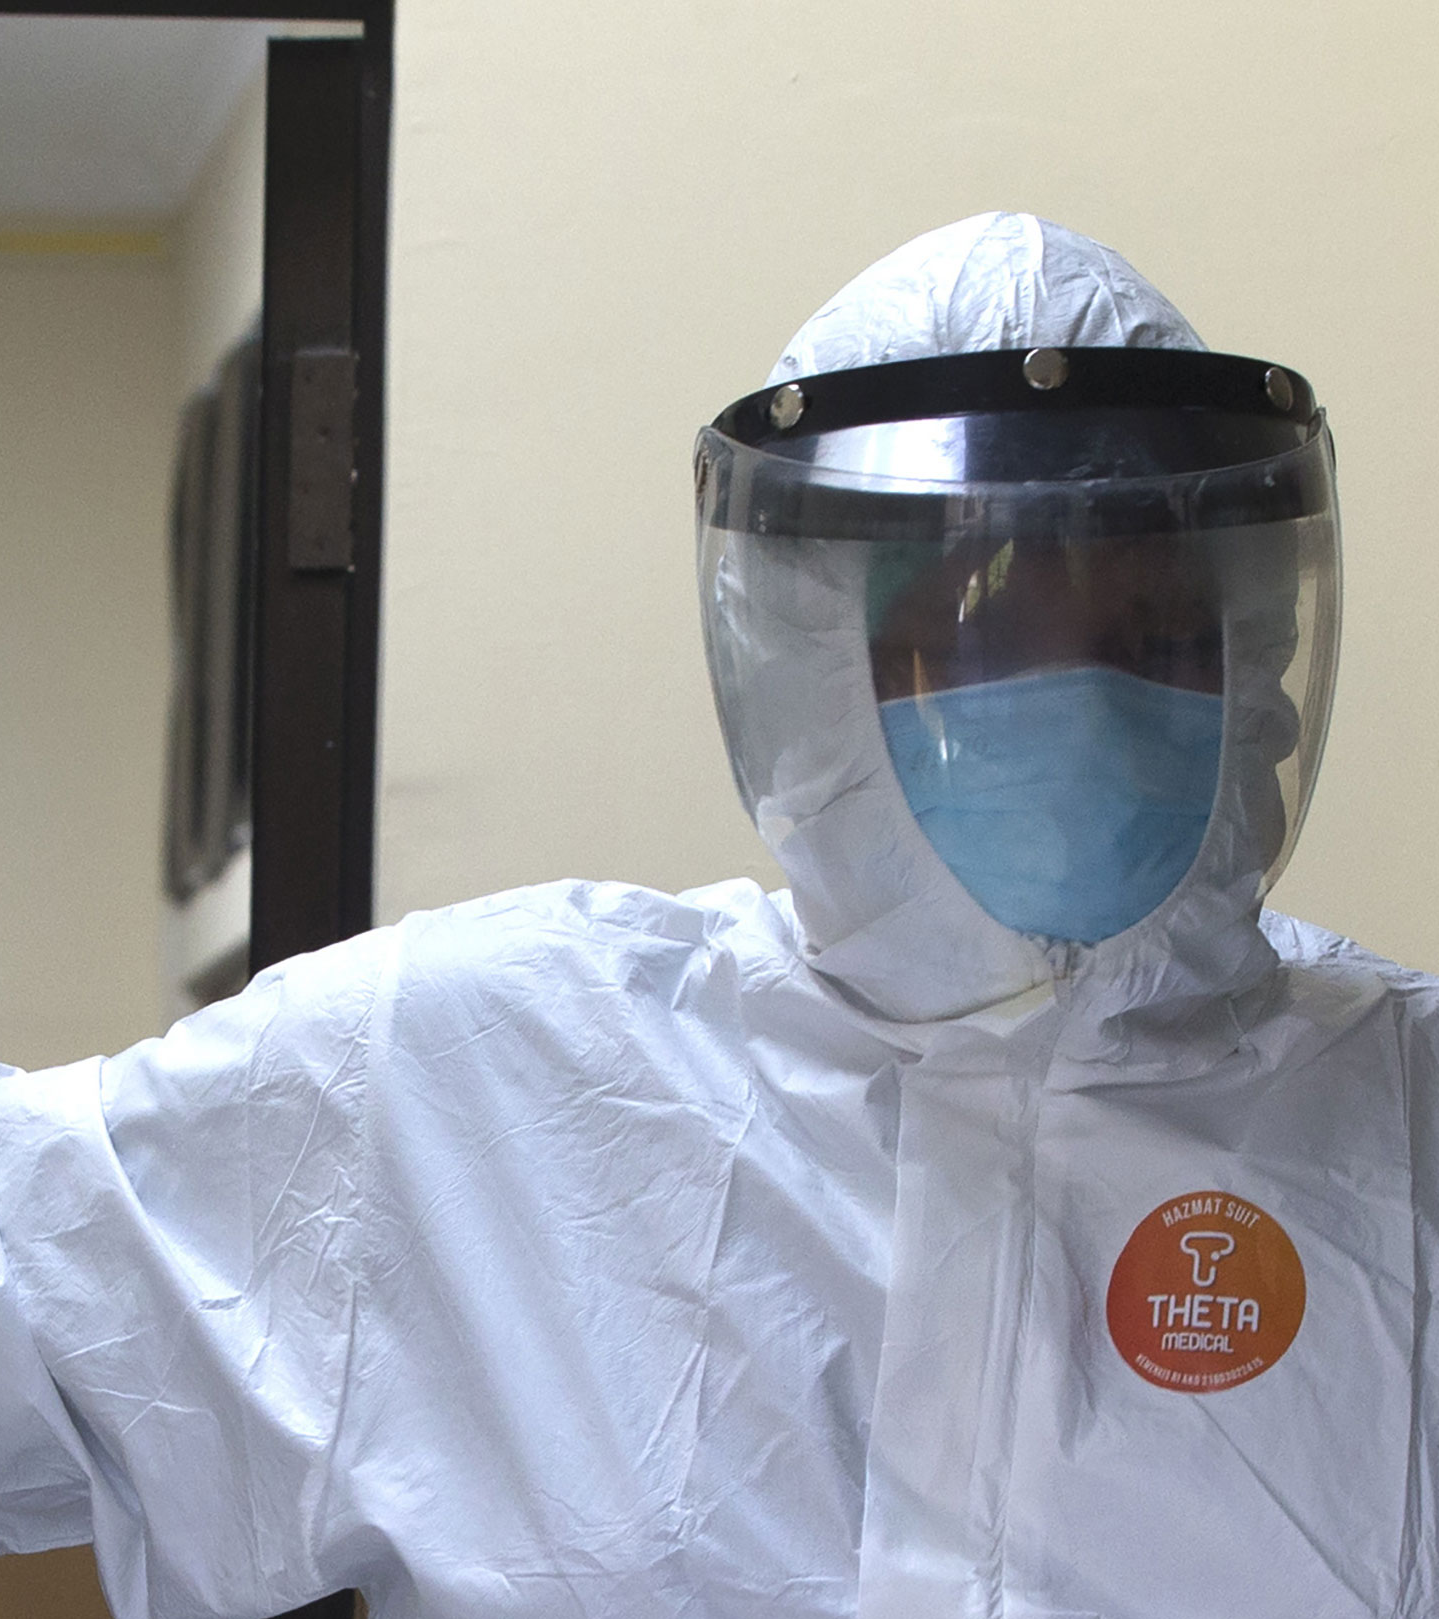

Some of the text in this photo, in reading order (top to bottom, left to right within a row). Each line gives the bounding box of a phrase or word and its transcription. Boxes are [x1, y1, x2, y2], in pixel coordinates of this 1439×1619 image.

[1161, 1198, 1261, 1229] HAZMAT SUIT
[1147, 1294, 1260, 1332] THETA
[1161, 1332, 1234, 1353] MEDICAL
